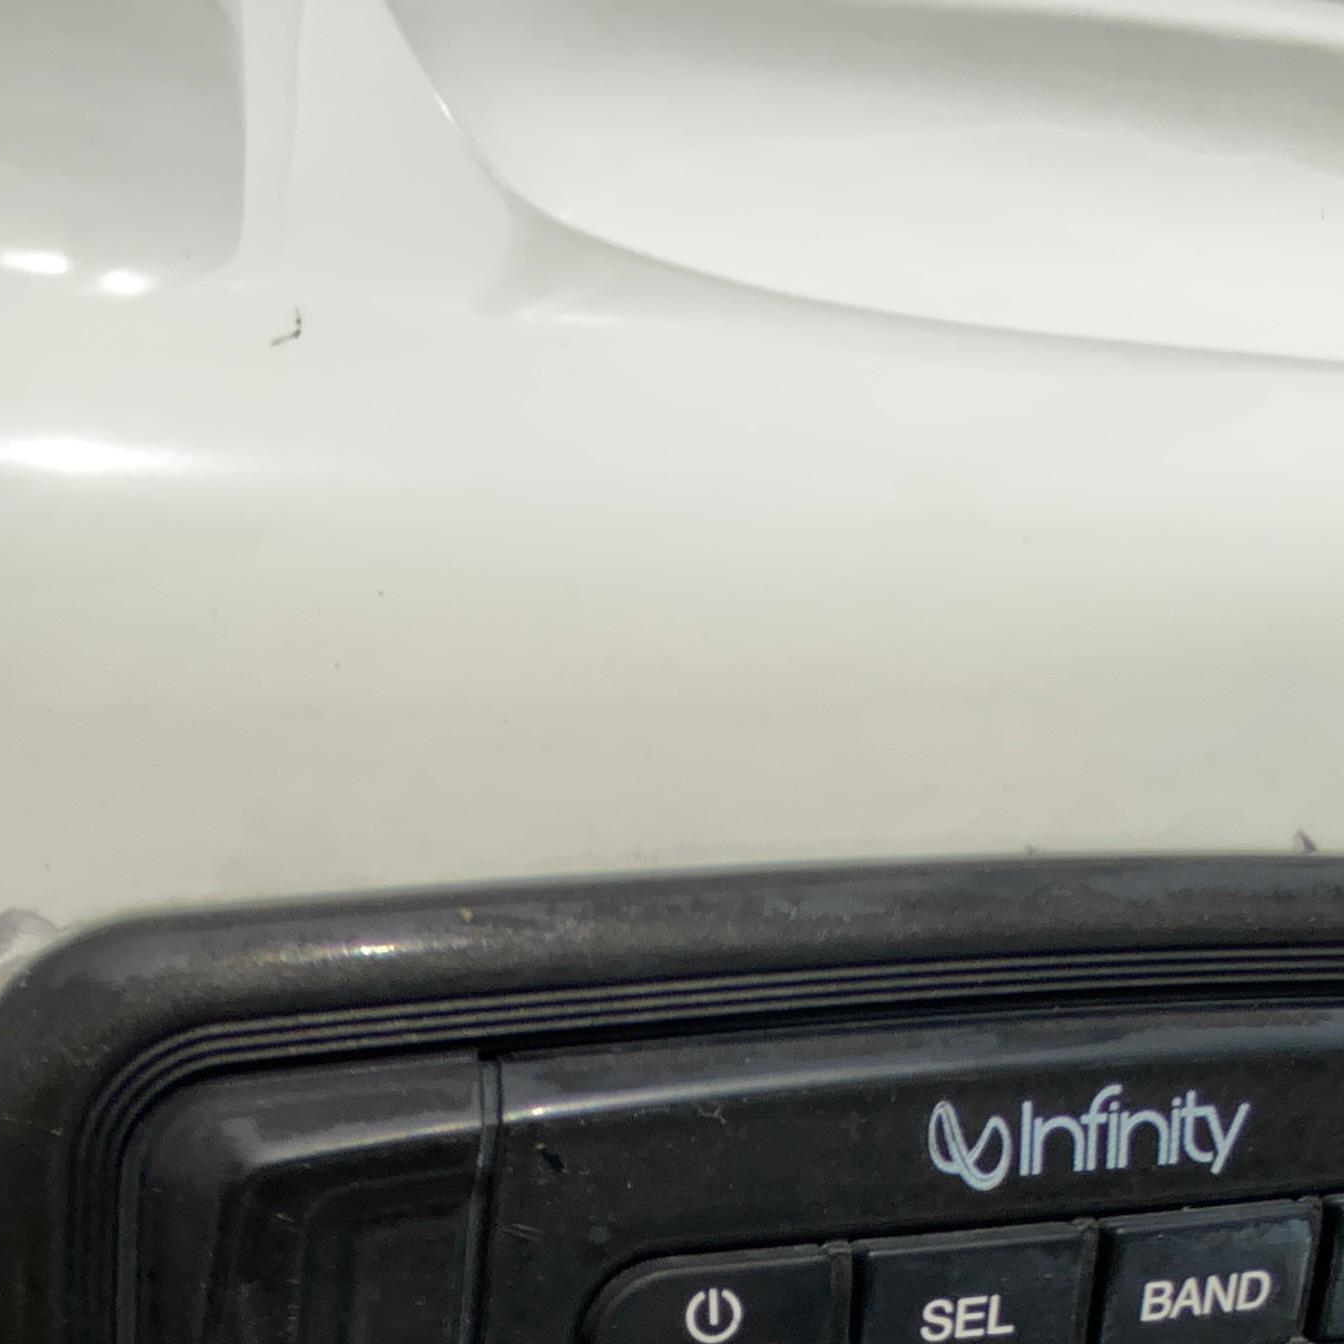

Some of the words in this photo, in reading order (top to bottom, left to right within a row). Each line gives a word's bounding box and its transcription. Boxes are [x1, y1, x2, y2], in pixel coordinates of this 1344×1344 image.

[1018, 1084, 1249, 1178] Infinity
[920, 1296, 1015, 1341] SEL
[1141, 1271, 1272, 1325] BAND
